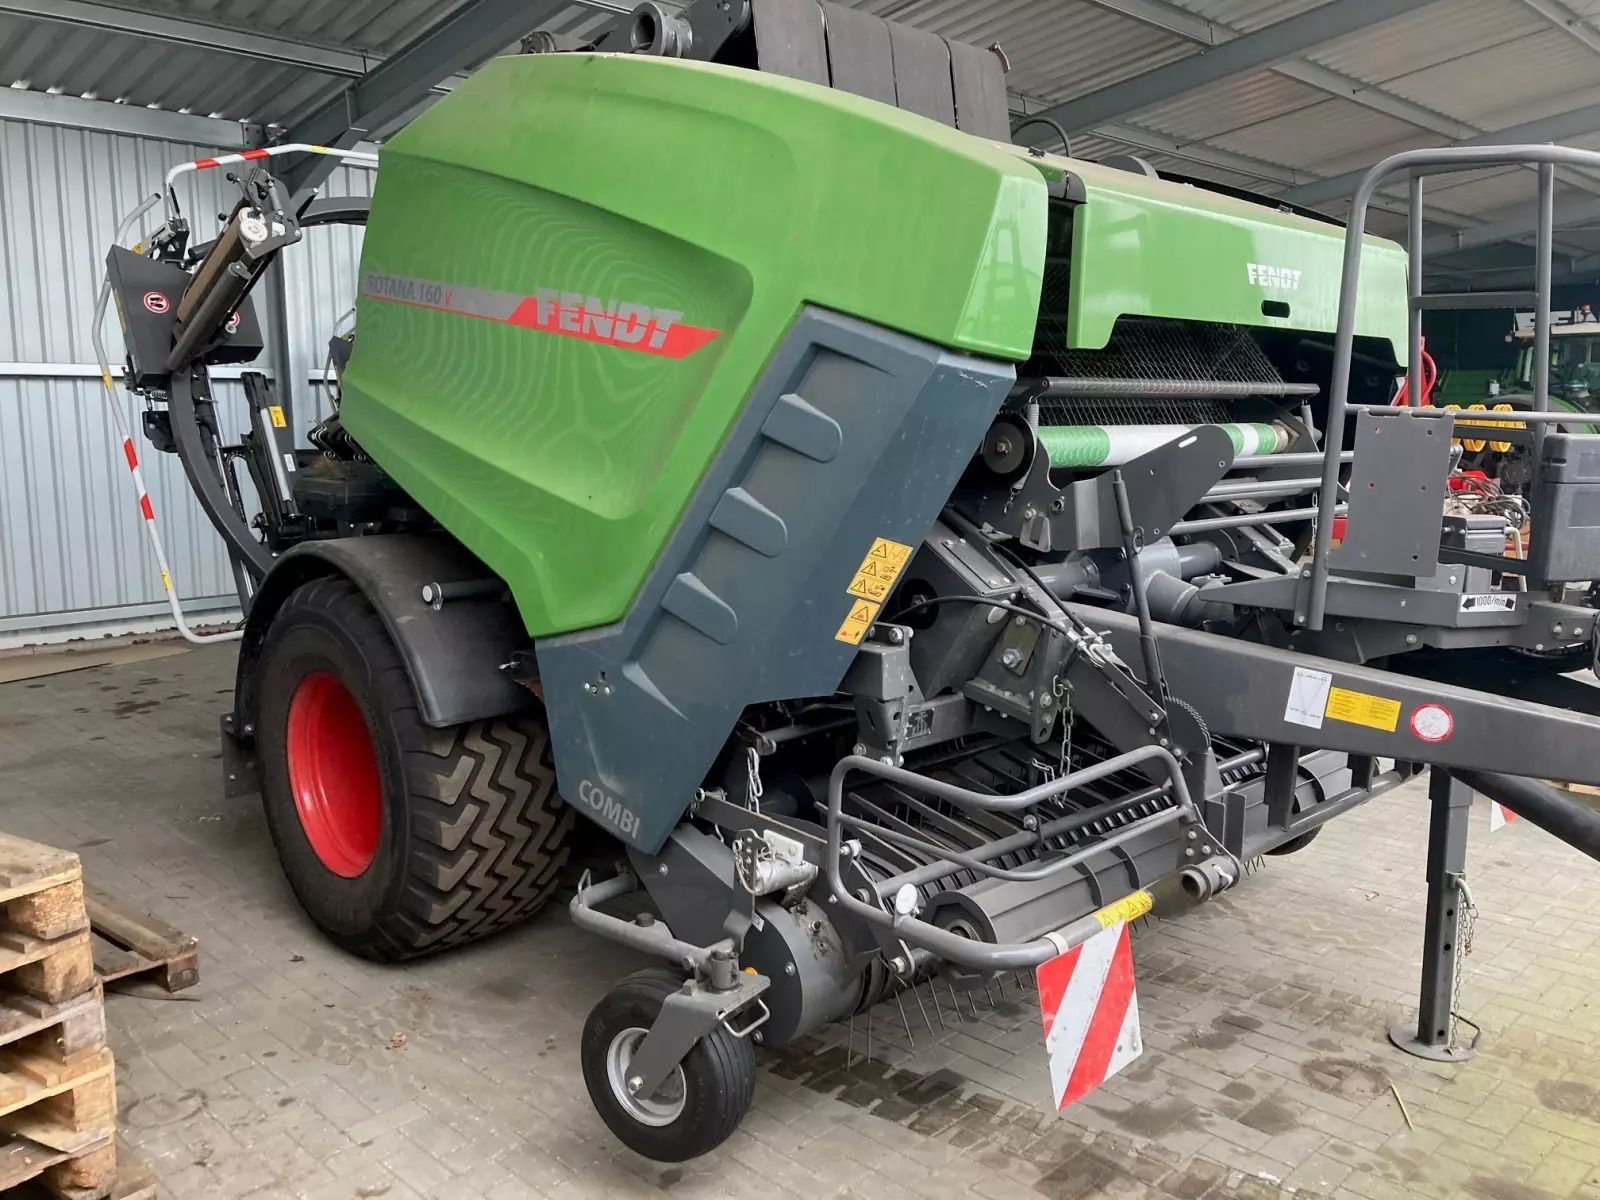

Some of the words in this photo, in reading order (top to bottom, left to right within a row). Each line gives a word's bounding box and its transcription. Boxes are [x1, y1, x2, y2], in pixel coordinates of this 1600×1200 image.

[365, 274, 417, 301] ROTANA
[1246, 262, 1303, 291] FENDT
[536, 286, 685, 350] FENDT
[579, 779, 641, 840] COMBI
